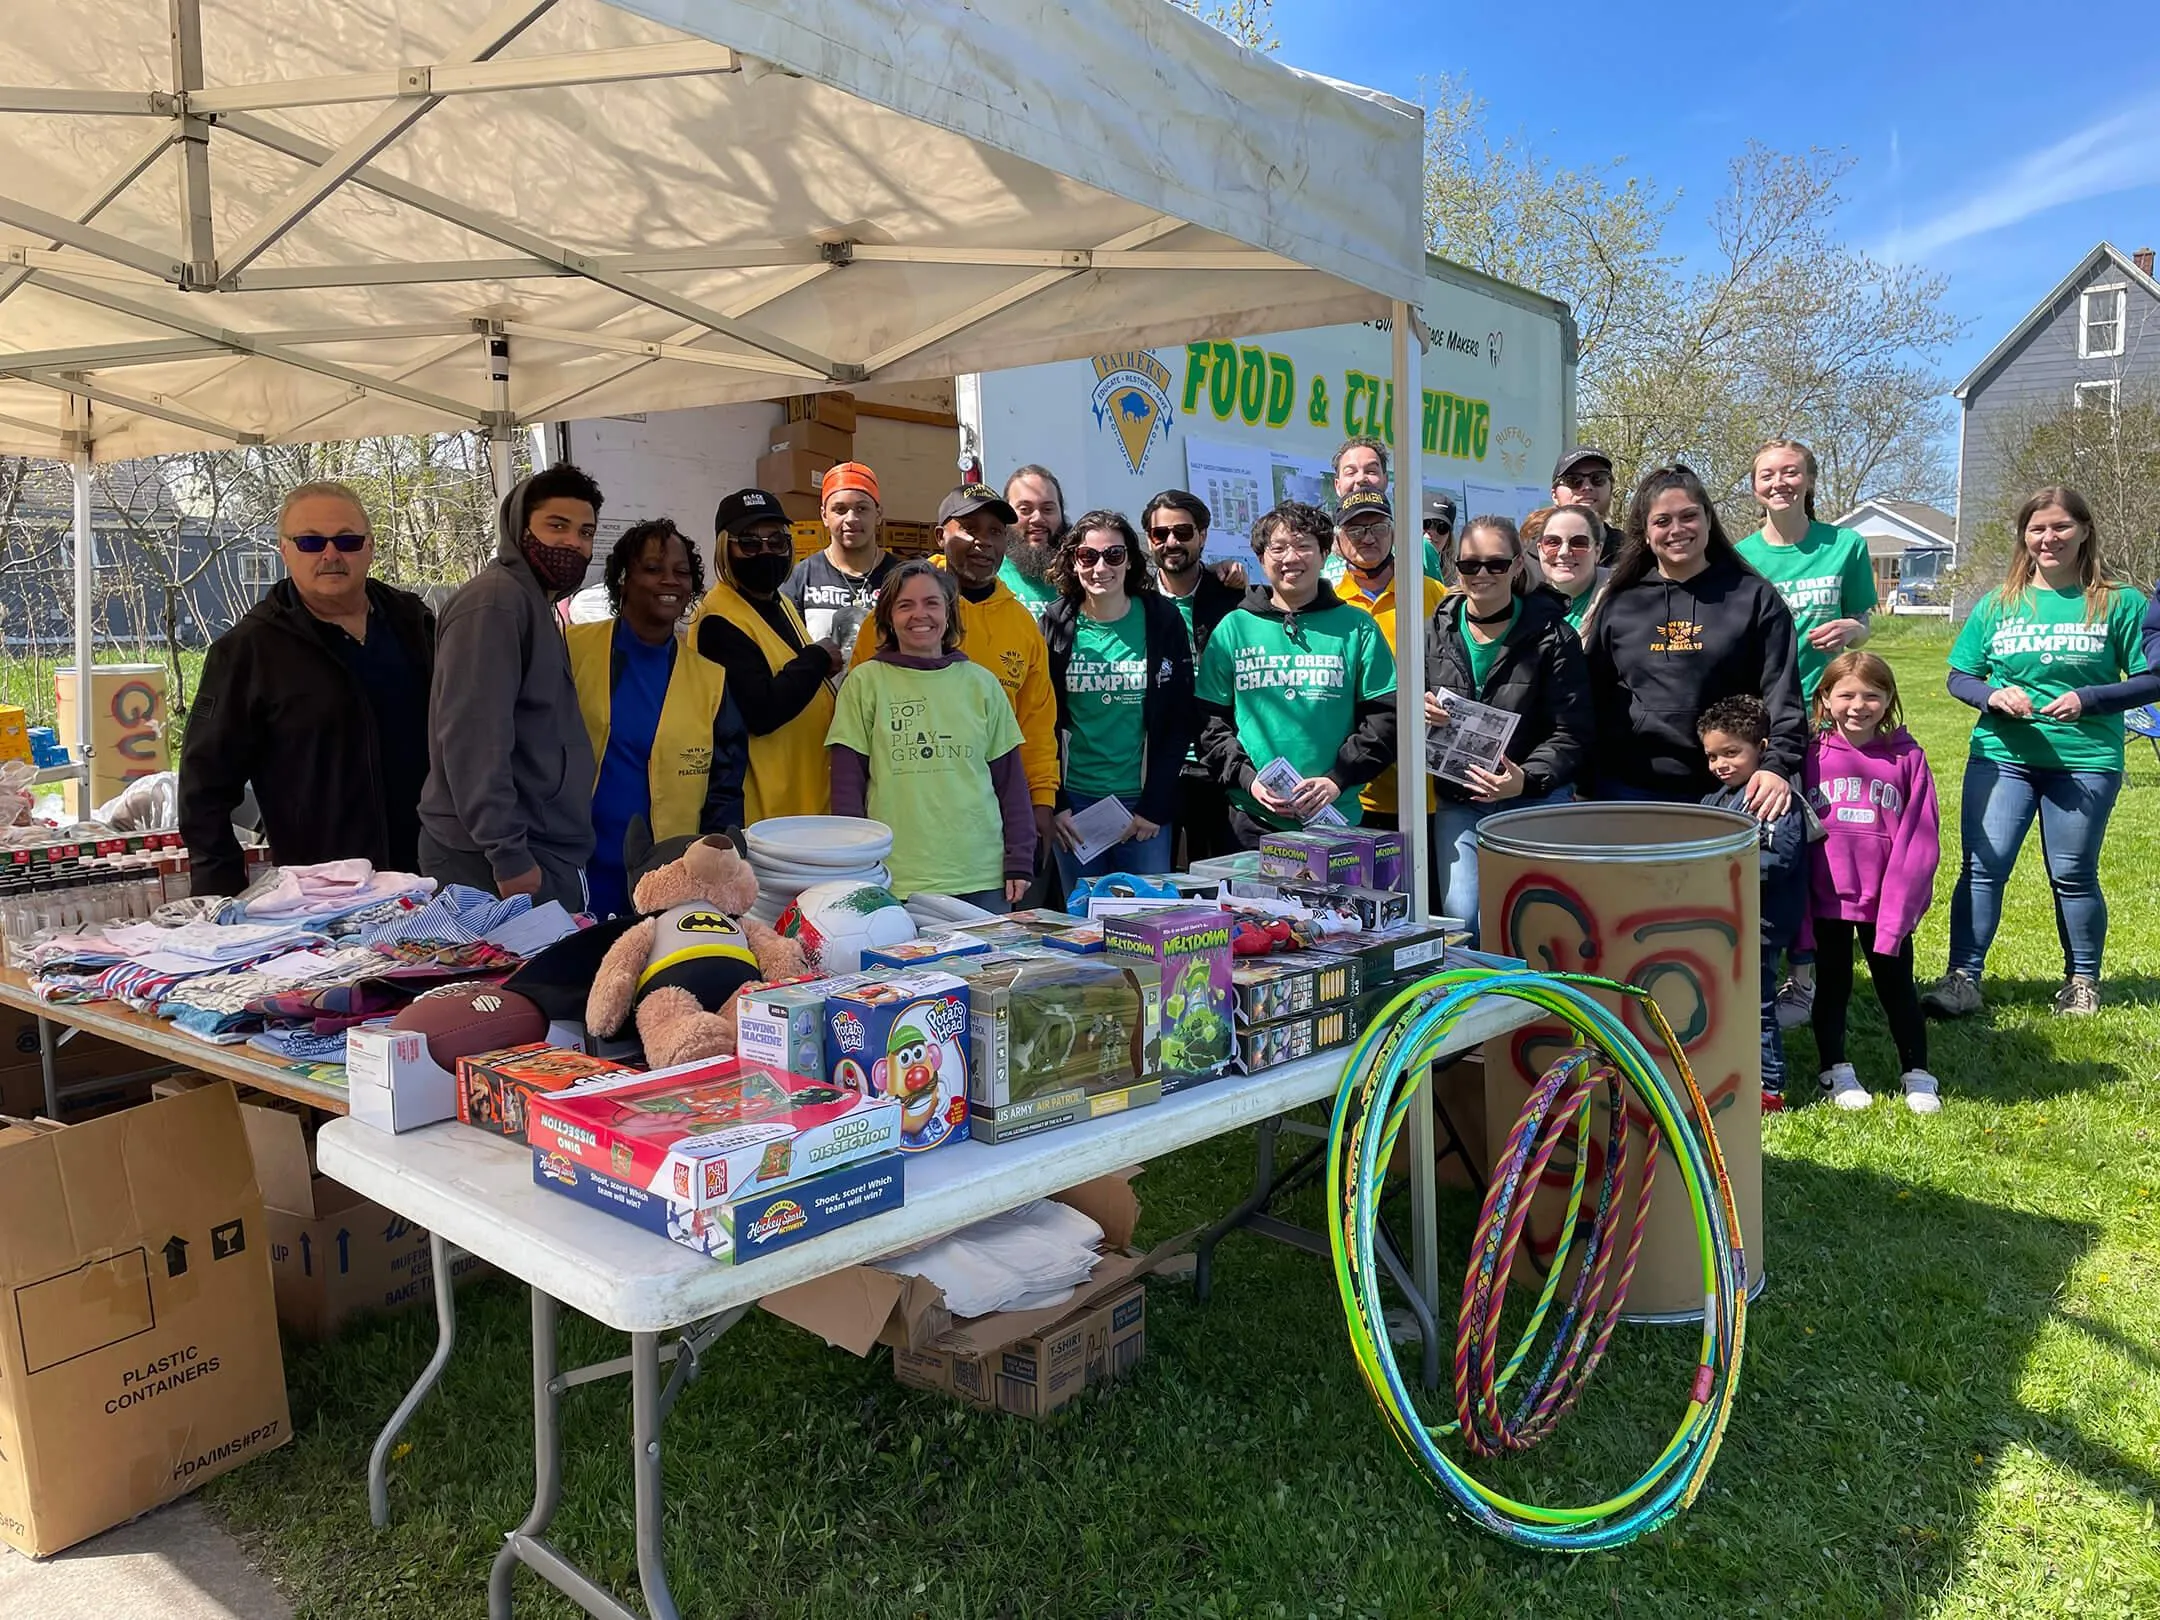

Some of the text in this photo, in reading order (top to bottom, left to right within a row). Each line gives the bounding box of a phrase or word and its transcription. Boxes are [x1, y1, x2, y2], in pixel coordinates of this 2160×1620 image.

[1097, 375, 1122, 401] EDUCATE
[1124, 374, 1153, 391] RESTORE
[1182, 338, 1491, 463] FOOD & CLHING
[1495, 425, 1533, 449] BUFFALO
[1667, 620, 1692, 629] WNY
[1234, 645, 1266, 658] I AM A
[1650, 641, 1702, 652] PEAEMAKERS
[1992, 634, 2105, 656] CHAMPION
[1065, 661, 1109, 674] AILEY
[1111, 658, 1147, 673] GREE
[1235, 653, 1344, 673] BAILEY GREEN
[1065, 672, 1148, 693] HAMPIO
[1235, 668, 1344, 691] CHAMPION
[890, 704, 926, 719] POP
[111, 680, 160, 786] GU
[891, 719, 912, 732] UP
[891, 744, 974, 762] GROUND
[1807, 777, 1862, 809] CAPE
[1262, 845, 1308, 862] MELTDOWN
[1328, 855, 1361, 869] MELTDOWN
[1106, 936, 1155, 956] MELTDOWN
[1163, 928, 1229, 957] MELTDOWN
[741, 1019, 776, 1034] SEWING
[833, 1019, 863, 1037] Potato
[927, 1004, 964, 1031] Potato
[741, 1030, 782, 1047] MACHINE
[937, 1017, 963, 1043] Head
[841, 1034, 863, 1051] Head
[997, 1092, 1081, 1122] US ARMY AIR PATROL
[541, 1113, 597, 1148] DISSECTION
[833, 1118, 869, 1140] DINO
[557, 1137, 582, 1156] DINO
[810, 1126, 890, 1163] DISSECTION
[707, 1162, 725, 1180] PLAY
[708, 1172, 715, 1186] 2
[590, 1172, 609, 1188] Shoot,
[610, 1180, 628, 1194] score!
[629, 1186, 649, 1201] Which
[598, 1186, 641, 1209] team will win?
[815, 1175, 892, 1208] Shoot, score! Which
[825, 1190, 884, 1214] team will win?
[746, 1208, 808, 1240] Hockey Sports
[271, 1243, 288, 1263] UP
[391, 1246, 432, 1273] MUFFIN
[385, 1282, 417, 1306] BAKE
[1050, 1332, 1081, 1357] T-SHIRT
[122, 1345, 199, 1387] PLASTIC
[104, 1357, 220, 1415] CONTAINERS
[173, 1420, 279, 1481] FDA/IMS#P27
